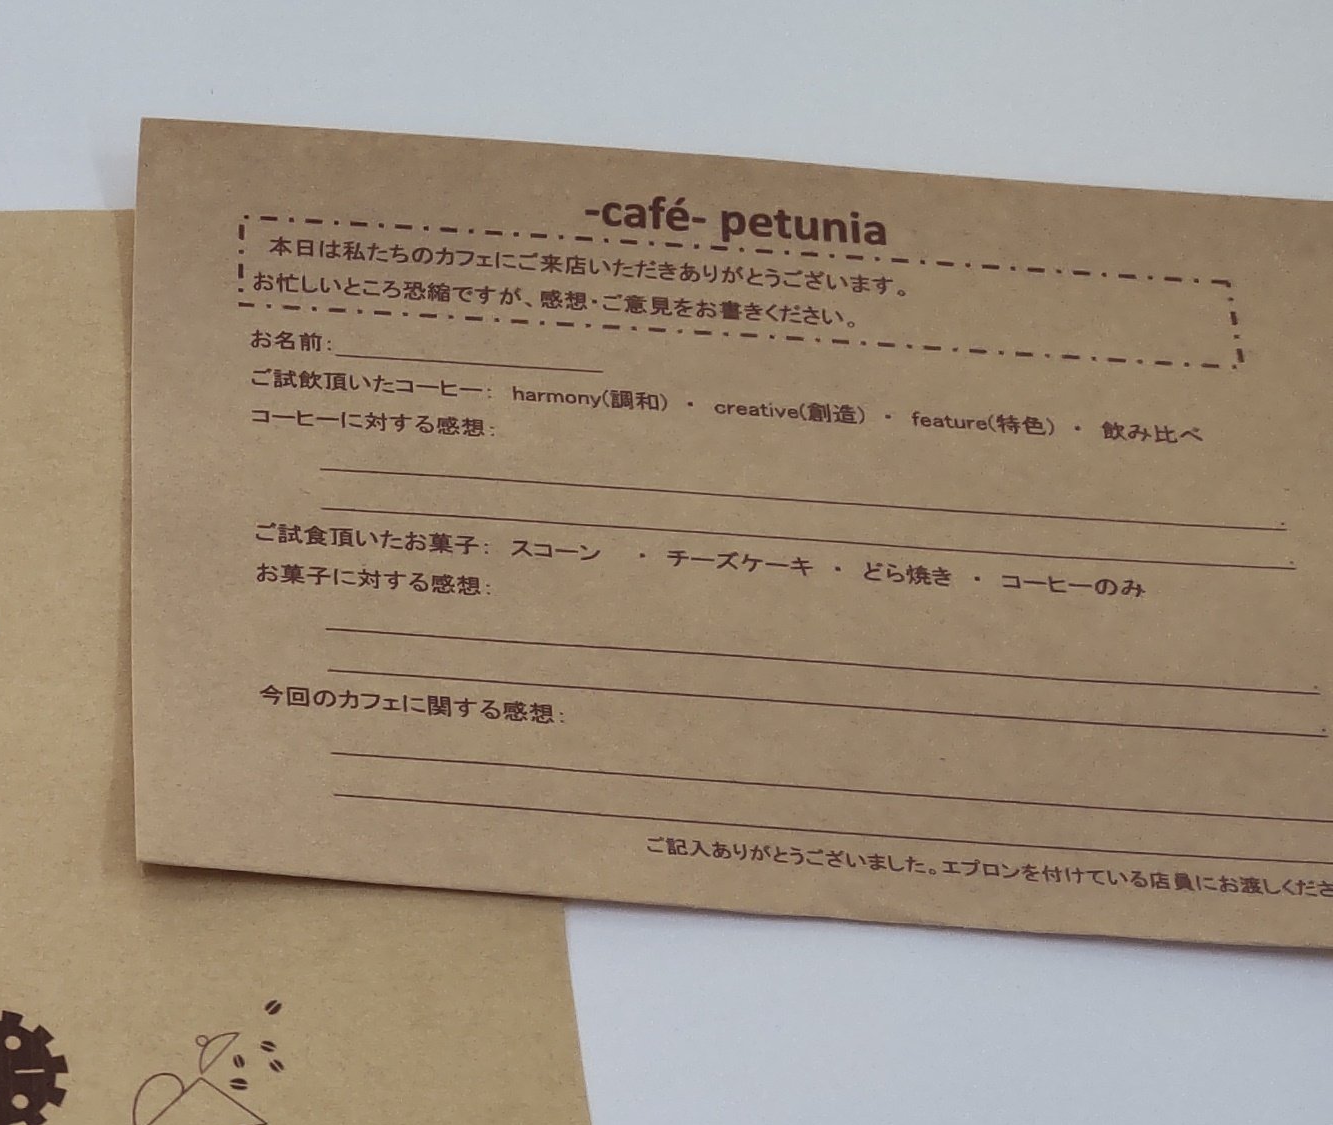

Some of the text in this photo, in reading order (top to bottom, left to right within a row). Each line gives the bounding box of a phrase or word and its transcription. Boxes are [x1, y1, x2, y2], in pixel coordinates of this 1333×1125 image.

[584, 196, 888, 246] -café- petunia
[269, 236, 907, 297] 本日は私たちのカフェにご来店いただきありがとうございます。
[1102, 421, 1204, 445] 飲み比べ
[511, 539, 601, 561] スコーン
[667, 549, 813, 577] チーズケーキ
[863, 561, 952, 587] どら焼き
[1002, 572, 1147, 598] コーヒーのみ
